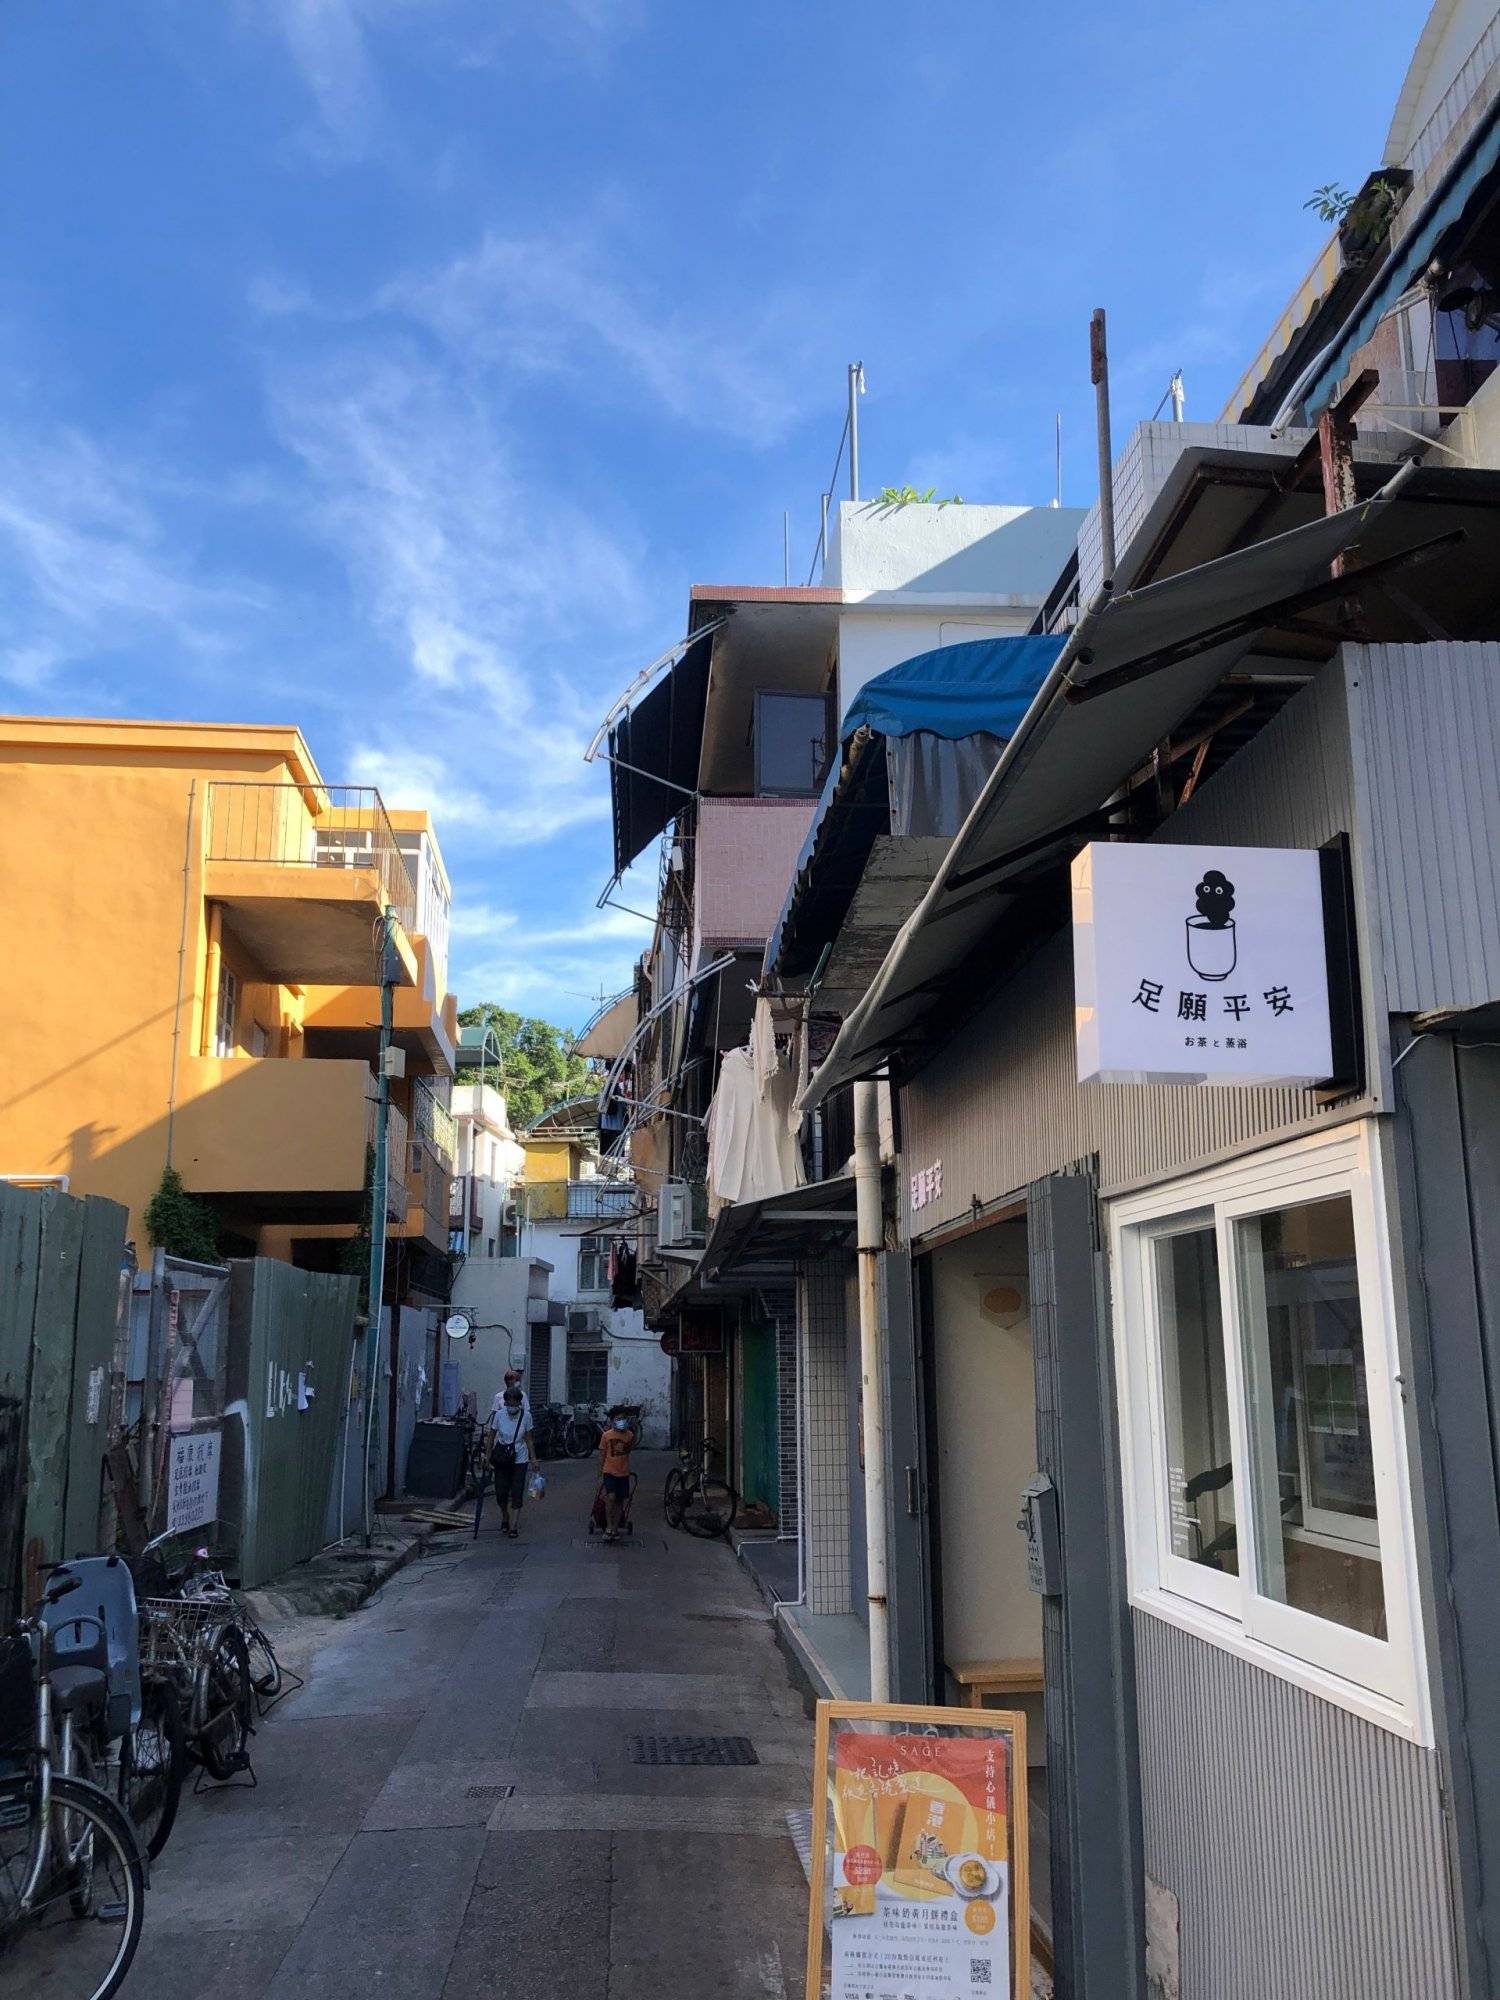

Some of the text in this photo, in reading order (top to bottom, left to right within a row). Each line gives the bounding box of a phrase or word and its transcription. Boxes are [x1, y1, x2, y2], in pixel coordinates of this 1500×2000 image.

[1131, 978, 1295, 1023] 足願平安
[1184, 1036, 1248, 1049] お茶と蒸浴
[900, 1745, 942, 1757] SAGE
